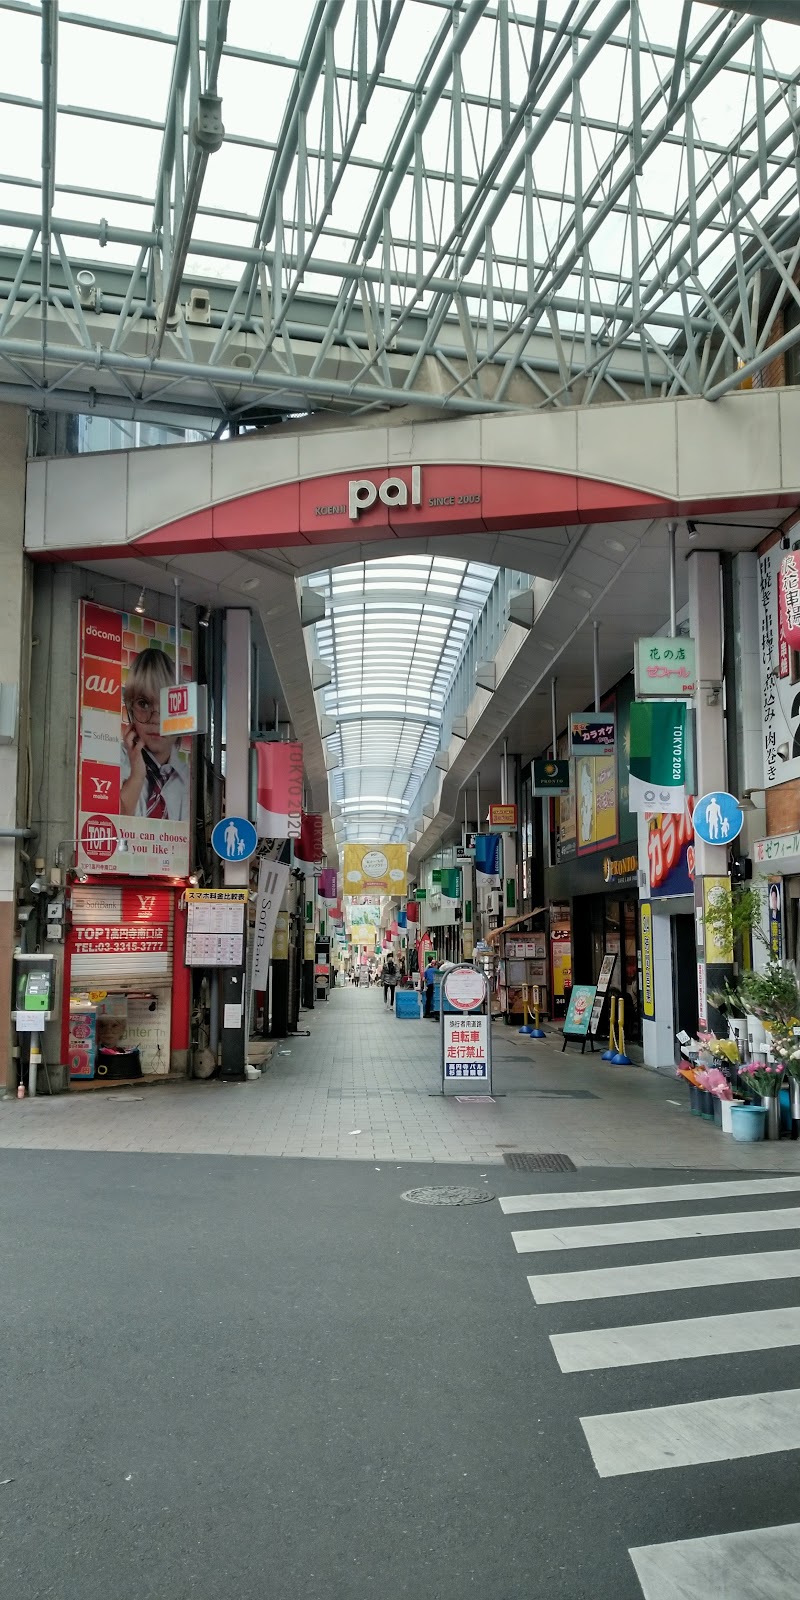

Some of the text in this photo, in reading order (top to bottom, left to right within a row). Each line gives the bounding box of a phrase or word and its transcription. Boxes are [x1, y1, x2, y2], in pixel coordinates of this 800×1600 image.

[315, 465, 482, 520] KOENJI pal SINCE 2003
[85, 625, 121, 643] docomo
[650, 647, 686, 660] 花の店
[85, 675, 119, 695] au
[682, 683, 695, 692] pal
[92, 732, 119, 743] SoftBank
[582, 726, 614, 742] カラオケ
[673, 725, 683, 780] TOKYO 2020
[90, 777, 112, 794] Y!
[287, 742, 303, 839] TOKYO 2020
[119, 828, 188, 843] You can choose
[132, 844, 148, 854] you
[152, 844, 169, 855] like
[189, 892, 245, 901] スマホ料金比較表
[86, 900, 117, 909] SoftBank
[76, 927, 164, 940] TOP1高円寺南口店
[75, 941, 164, 953] TEL:03-3315-3777
[452, 1031, 480, 1043] 自転車
[447, 1046, 485, 1059] 走行禁止
